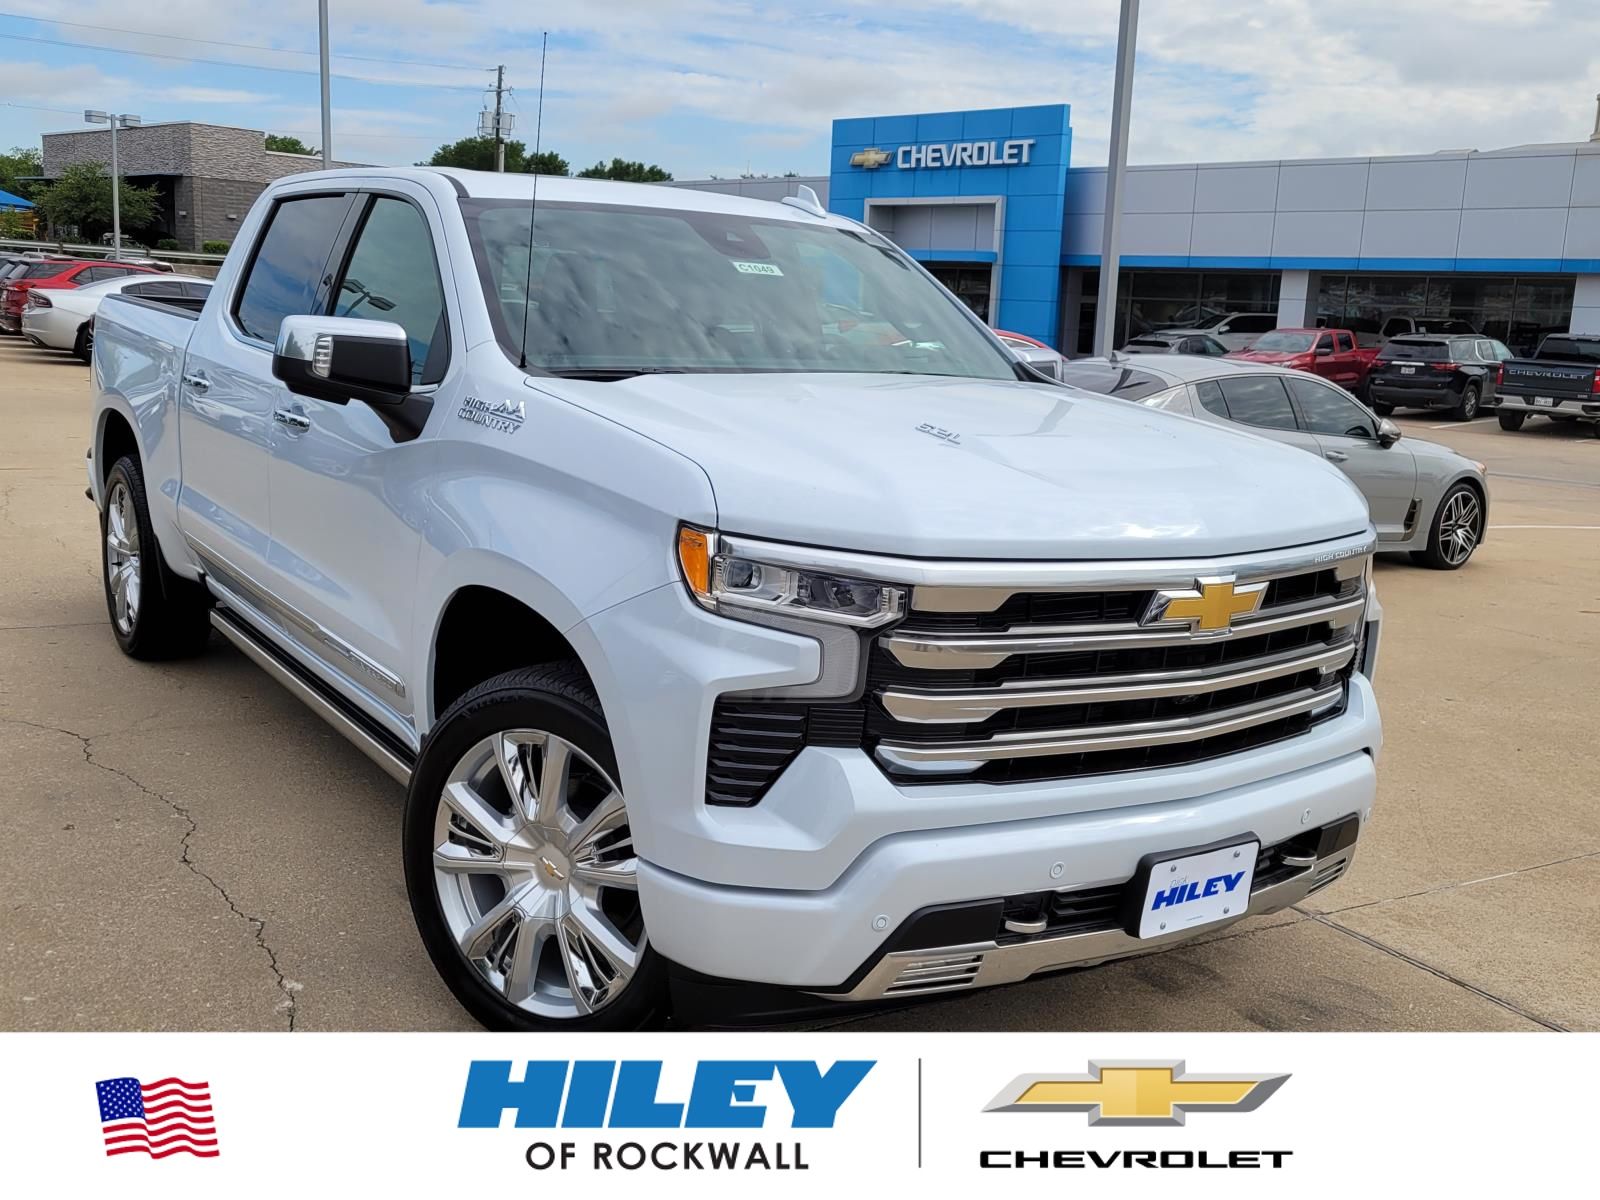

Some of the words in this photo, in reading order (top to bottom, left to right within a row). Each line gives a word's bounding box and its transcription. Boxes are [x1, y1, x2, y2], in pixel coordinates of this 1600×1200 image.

[896, 138, 1036, 169] CHEVROLET
[738, 262, 776, 274] C1049
[1508, 368, 1588, 380] CHEVROLET
[457, 407, 521, 435] COUNTRY
[1314, 553, 1334, 564] HIGH
[1151, 870, 1246, 911] HILEY
